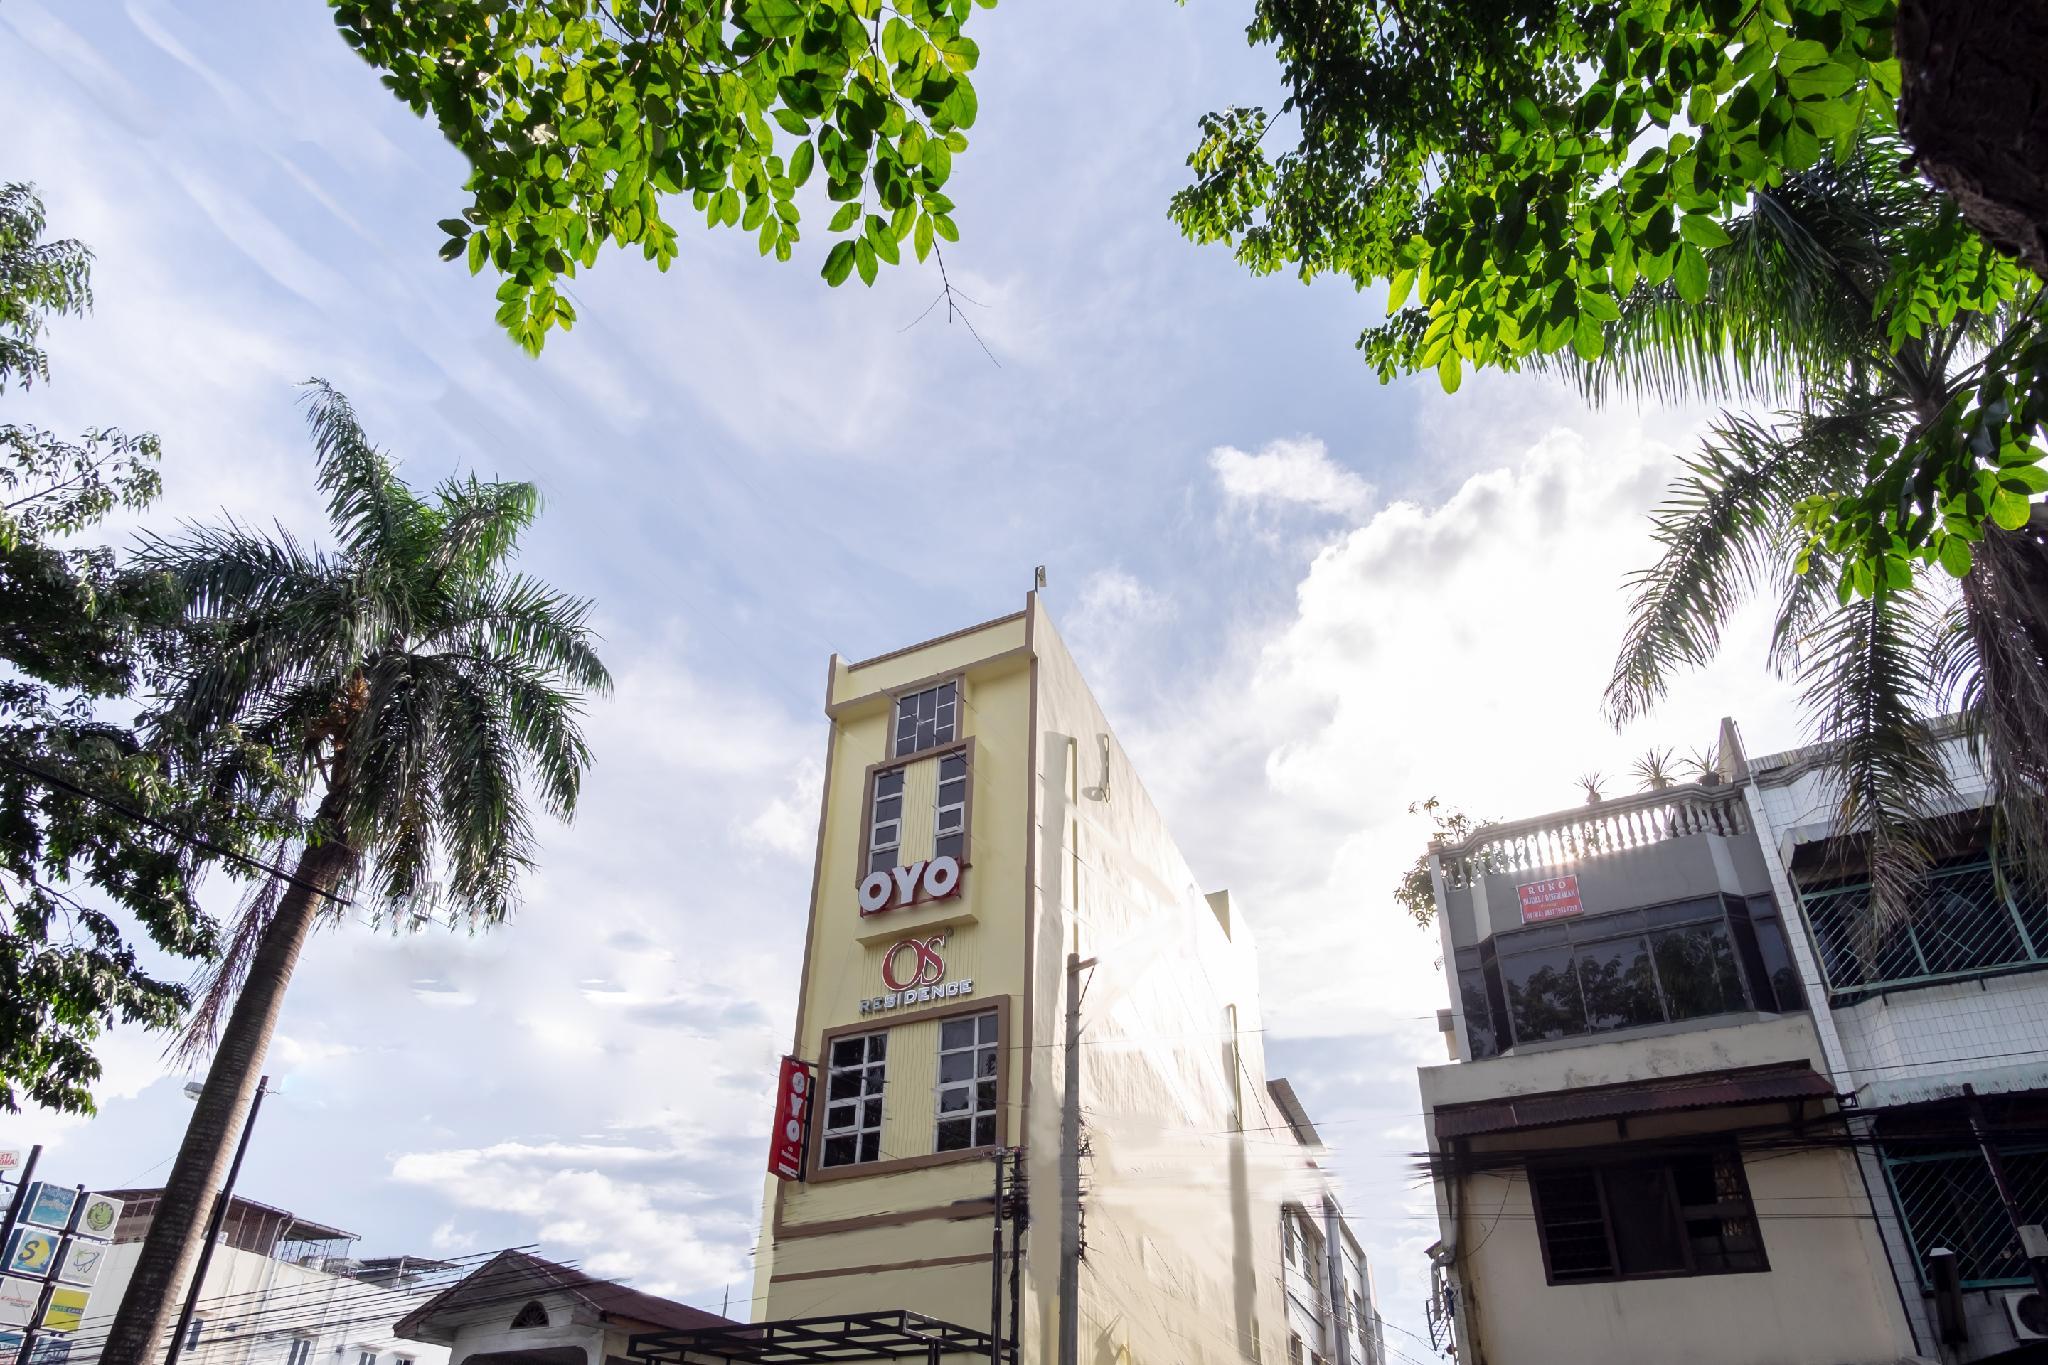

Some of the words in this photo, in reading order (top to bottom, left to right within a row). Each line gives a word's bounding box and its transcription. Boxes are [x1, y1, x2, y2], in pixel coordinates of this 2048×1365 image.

[859, 856, 960, 912] OYO
[1528, 881, 1566, 895] RUKO
[882, 935, 946, 991] OS
[859, 979, 973, 1015] RESIDENCE
[786, 1071, 805, 1142] OYO
